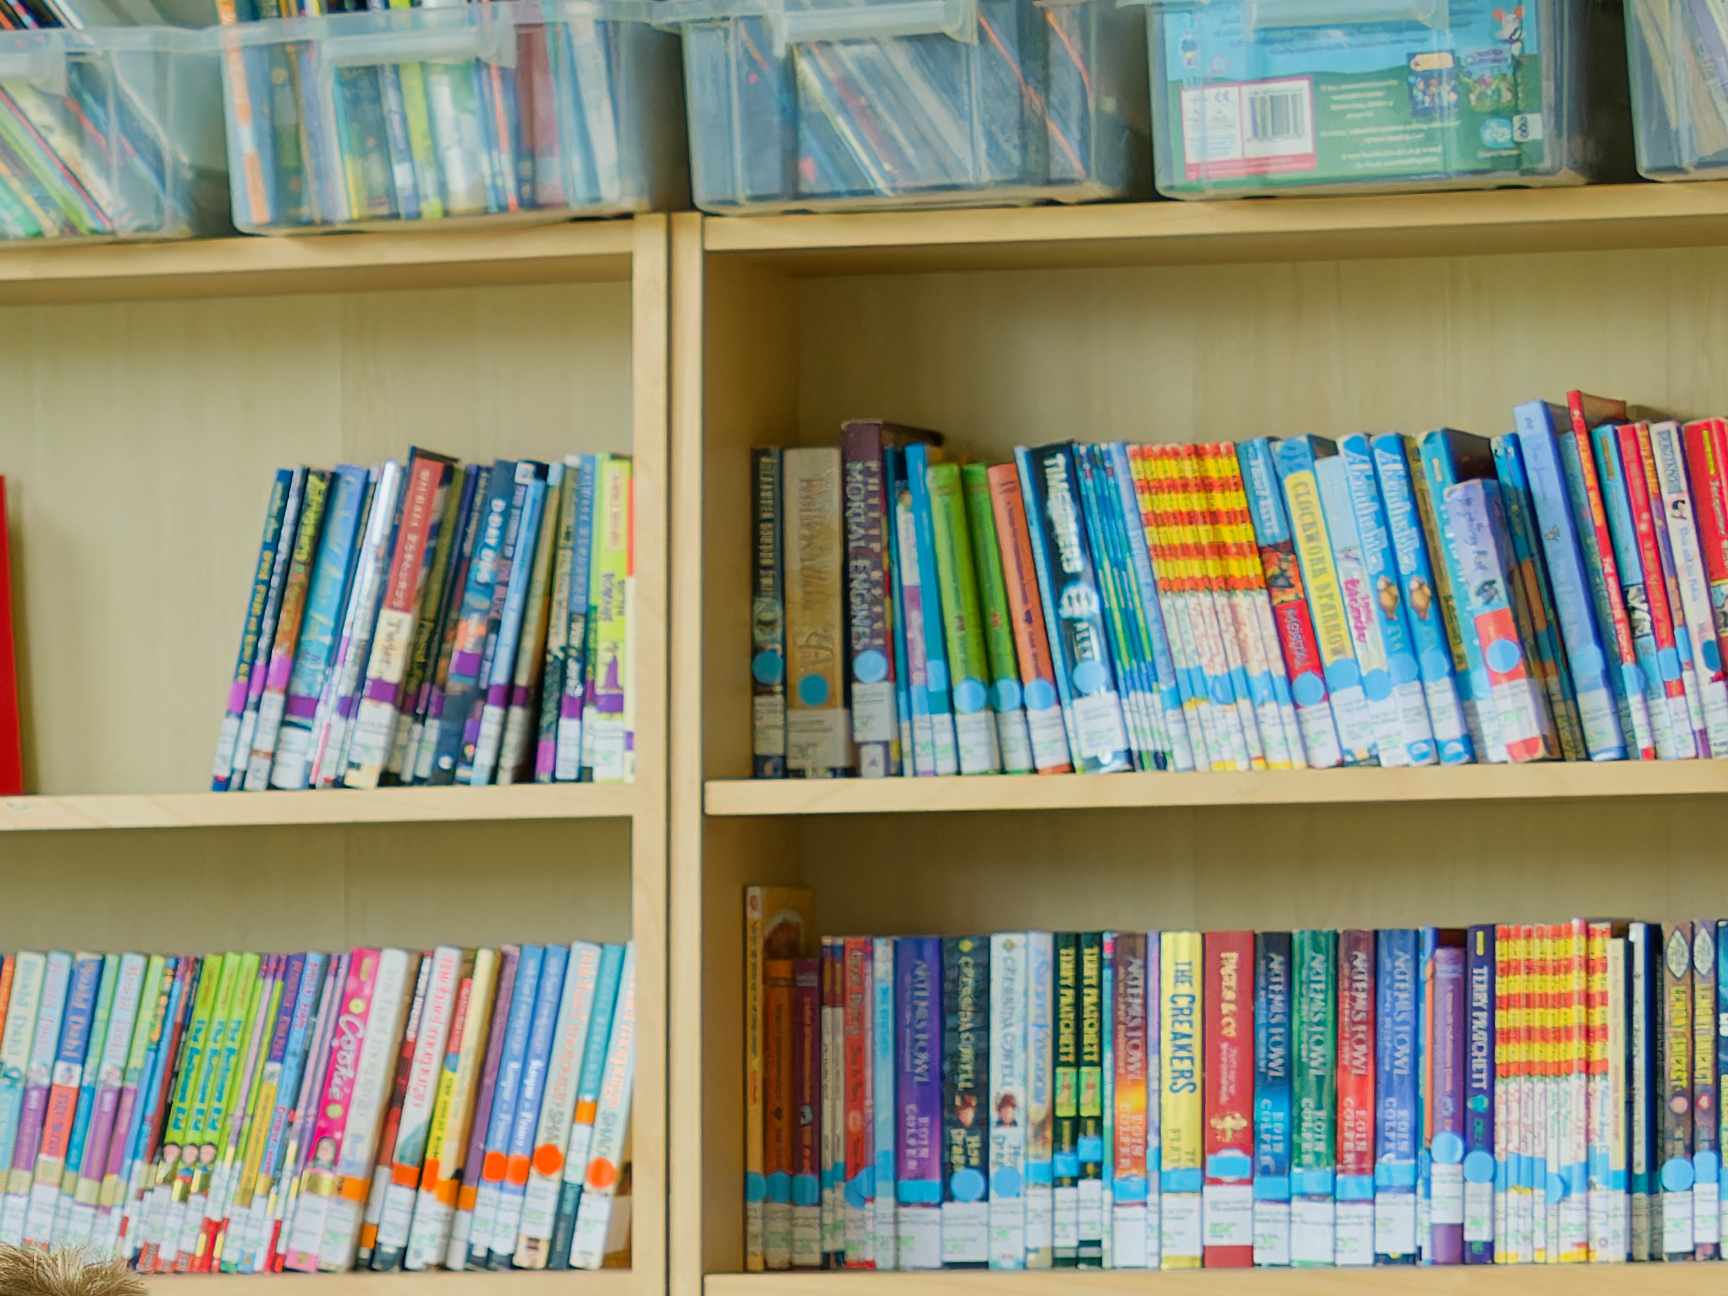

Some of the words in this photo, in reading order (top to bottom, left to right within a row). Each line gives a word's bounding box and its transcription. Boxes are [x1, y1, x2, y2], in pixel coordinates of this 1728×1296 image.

[1174, 960, 1194, 988] THE
[1471, 965, 1489, 1009] TERRY
[329, 1014, 364, 1100] Cookie
[1169, 993, 1197, 1094] CREAKERS
[1471, 1011, 1488, 1090] PRATCHETT
